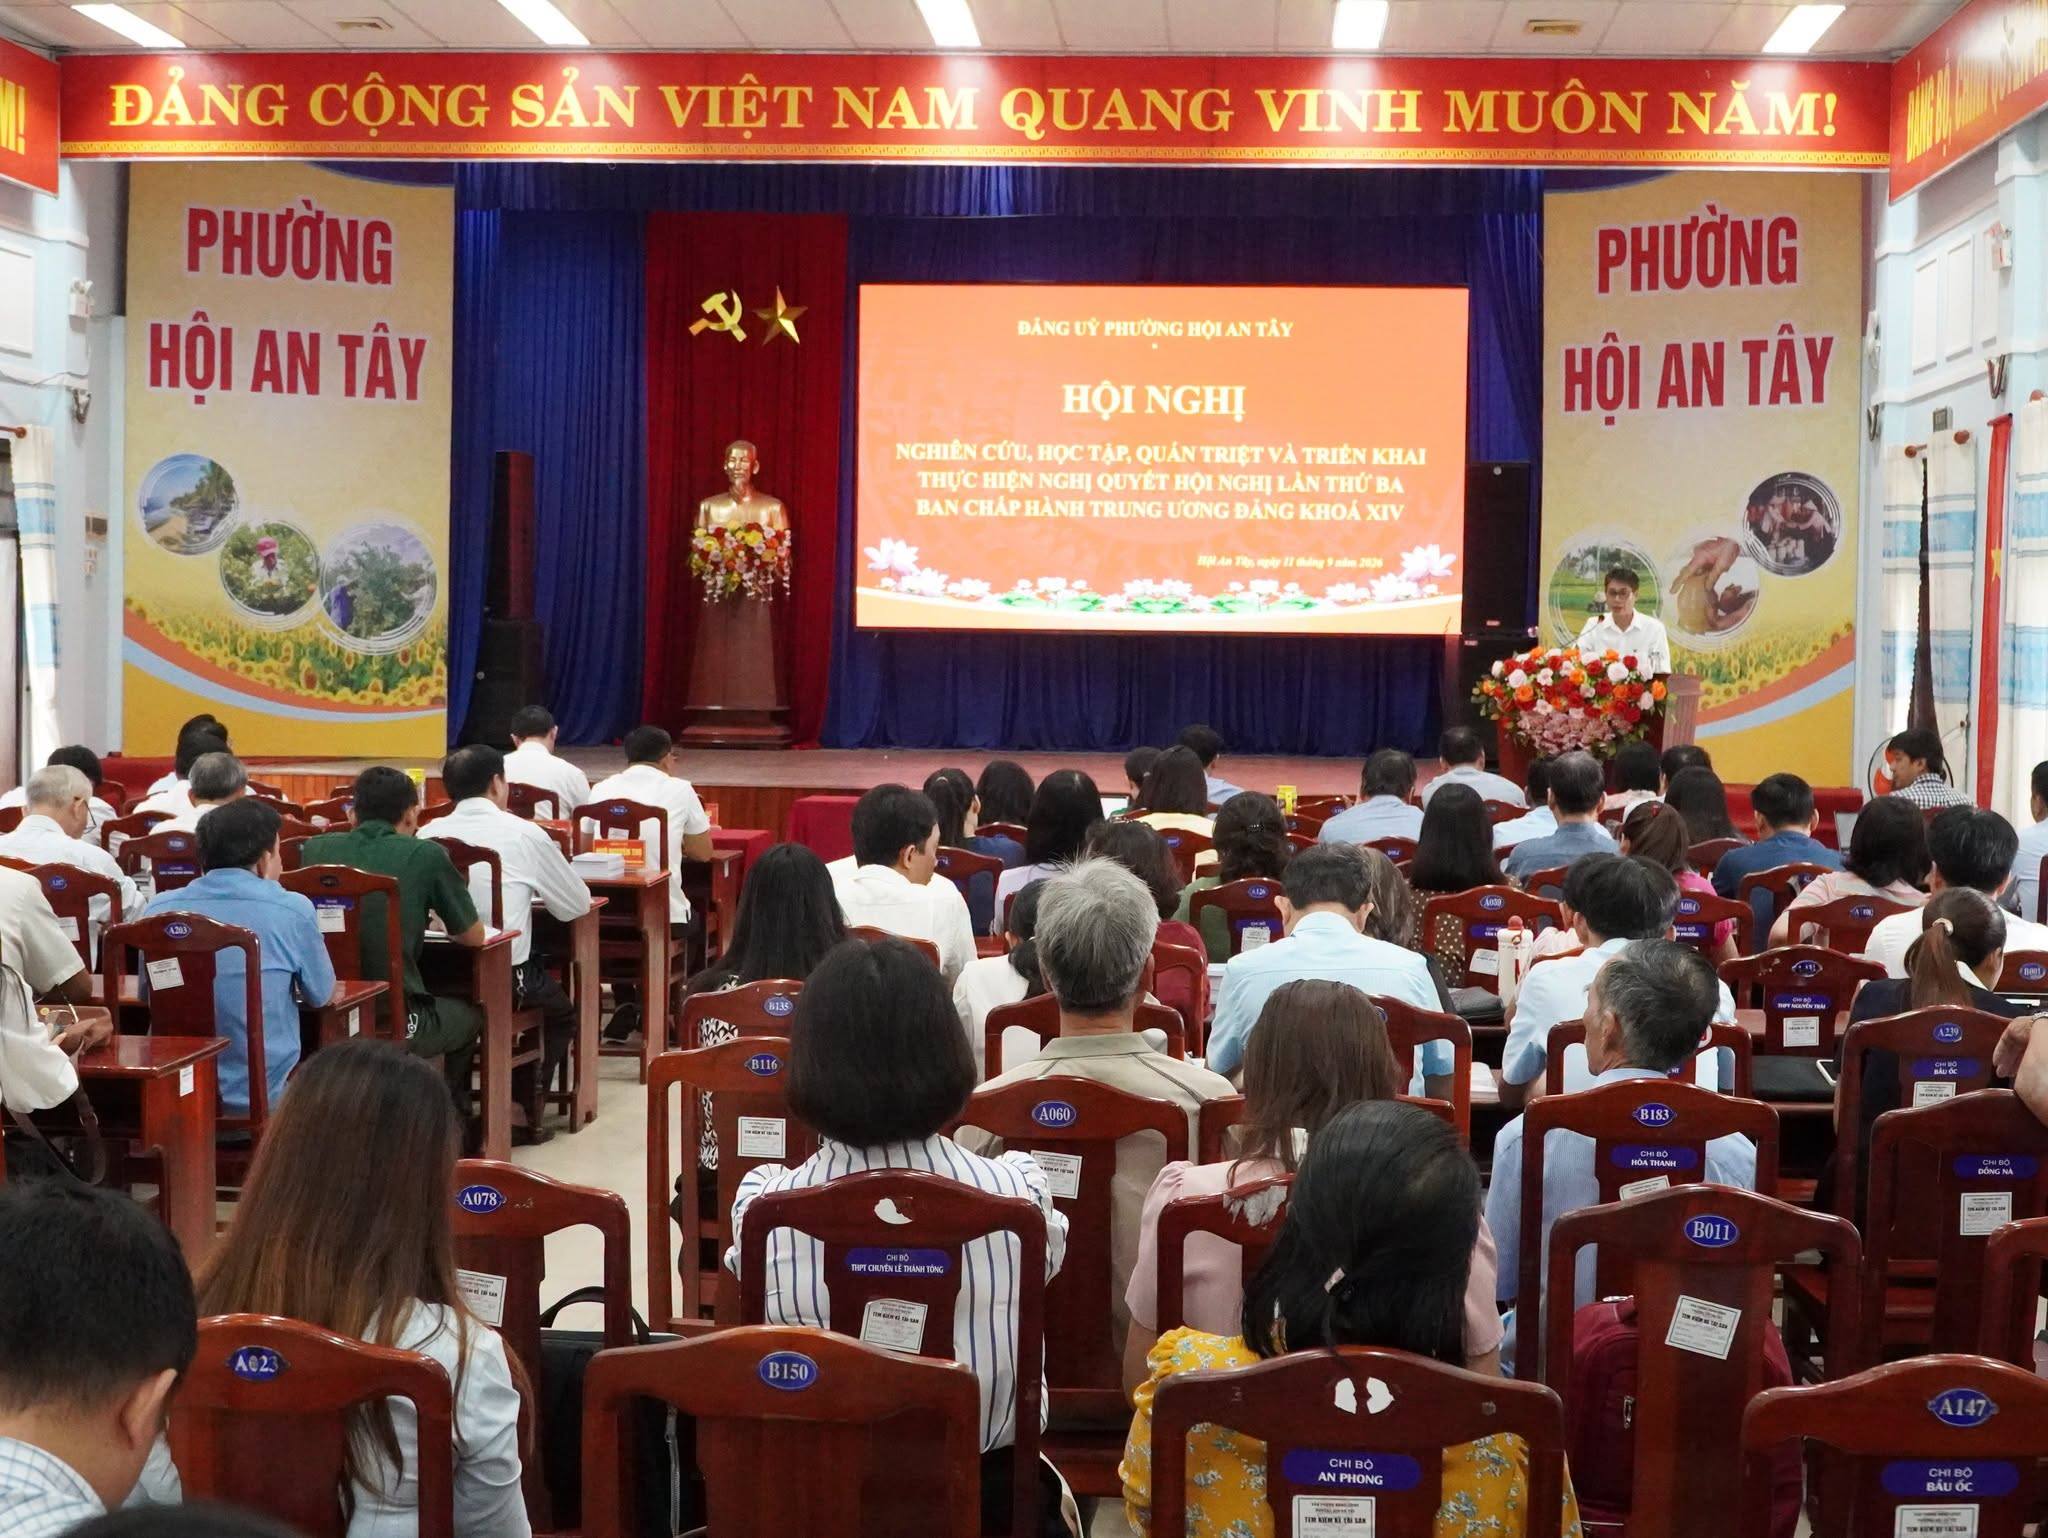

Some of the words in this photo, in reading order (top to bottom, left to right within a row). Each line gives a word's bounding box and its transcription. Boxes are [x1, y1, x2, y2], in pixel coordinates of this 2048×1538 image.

[109, 65, 288, 127] ĐẢNG
[310, 71, 489, 137] CỘNG
[510, 66, 640, 129] SẢN
[658, 73, 812, 139] VIỆT
[832, 86, 979, 130] NAM
[1000, 87, 1235, 140] QUANG
[1255, 89, 1422, 133] VINH
[1443, 78, 1648, 134] MUÔN
[1667, 79, 1838, 138] NĂM!
[187, 198, 392, 285] PHƯỜNG
[1598, 204, 1797, 294] PHƯỜNG
[1104, 317, 1183, 337] PHƯỜNG
[1188, 320, 1222, 340] HỘI
[1225, 322, 1252, 337] AN
[1256, 319, 1293, 337] TÂY
[150, 310, 232, 405] HỘI
[250, 329, 320, 395] AN
[337, 322, 427, 400] TÂY
[1564, 332, 1640, 426] HỘI
[1656, 341, 1725, 408] AN
[1741, 323, 1834, 406] TÂY
[1062, 380, 1136, 421] HỘI
[1145, 385, 1247, 422] NGHỊ
[896, 439, 976, 460] NGHIÊN
[983, 440, 1033, 462] CỨU,
[1037, 444, 1084, 465] HỌC
[1137, 442, 1196, 463] QUÁN
[1200, 445, 1264, 466] TRIỆT
[1268, 444, 1298, 464] VÀ
[1372, 448, 1426, 465] KHAI
[918, 469, 977, 491] THỰC
[983, 470, 1033, 492] HIỆN
[1039, 472, 1092, 493] NGHỊ
[1097, 470, 1169, 491] QUYẾT
[1174, 473, 1213, 494] HỘI
[1218, 474, 1272, 495] NGHỊ
[1325, 472, 1373, 493] THỨ
[1376, 477, 1404, 494] BA
[917, 499, 958, 516] BAN
[1024, 496, 1084, 517] HÀNH
[1090, 501, 1163, 518] TRUNG
[1167, 501, 1229, 519] ƯƠNG
[1300, 500, 1361, 521] KHOÁ
[1366, 504, 1405, 521] XIV
[750, 1058, 778, 1072] B116
[1039, 1106, 1071, 1122] A060
[1640, 1108, 1669, 1121] B183
[1650, 1159, 1676, 1167] THANH
[462, 1192, 498, 1207] A078
[1693, 1221, 1729, 1241] B011
[769, 1362, 809, 1381] B150
[1939, 1398, 1986, 1417] A147
[1329, 1458, 1351, 1469] CHI
[1355, 1458, 1374, 1471] BỘ
[1929, 1468, 1950, 1477] CHI
[1954, 1467, 1973, 1478] BỘ
[1318, 1471, 1336, 1482] AN
[1339, 1473, 1383, 1485] PHONG
